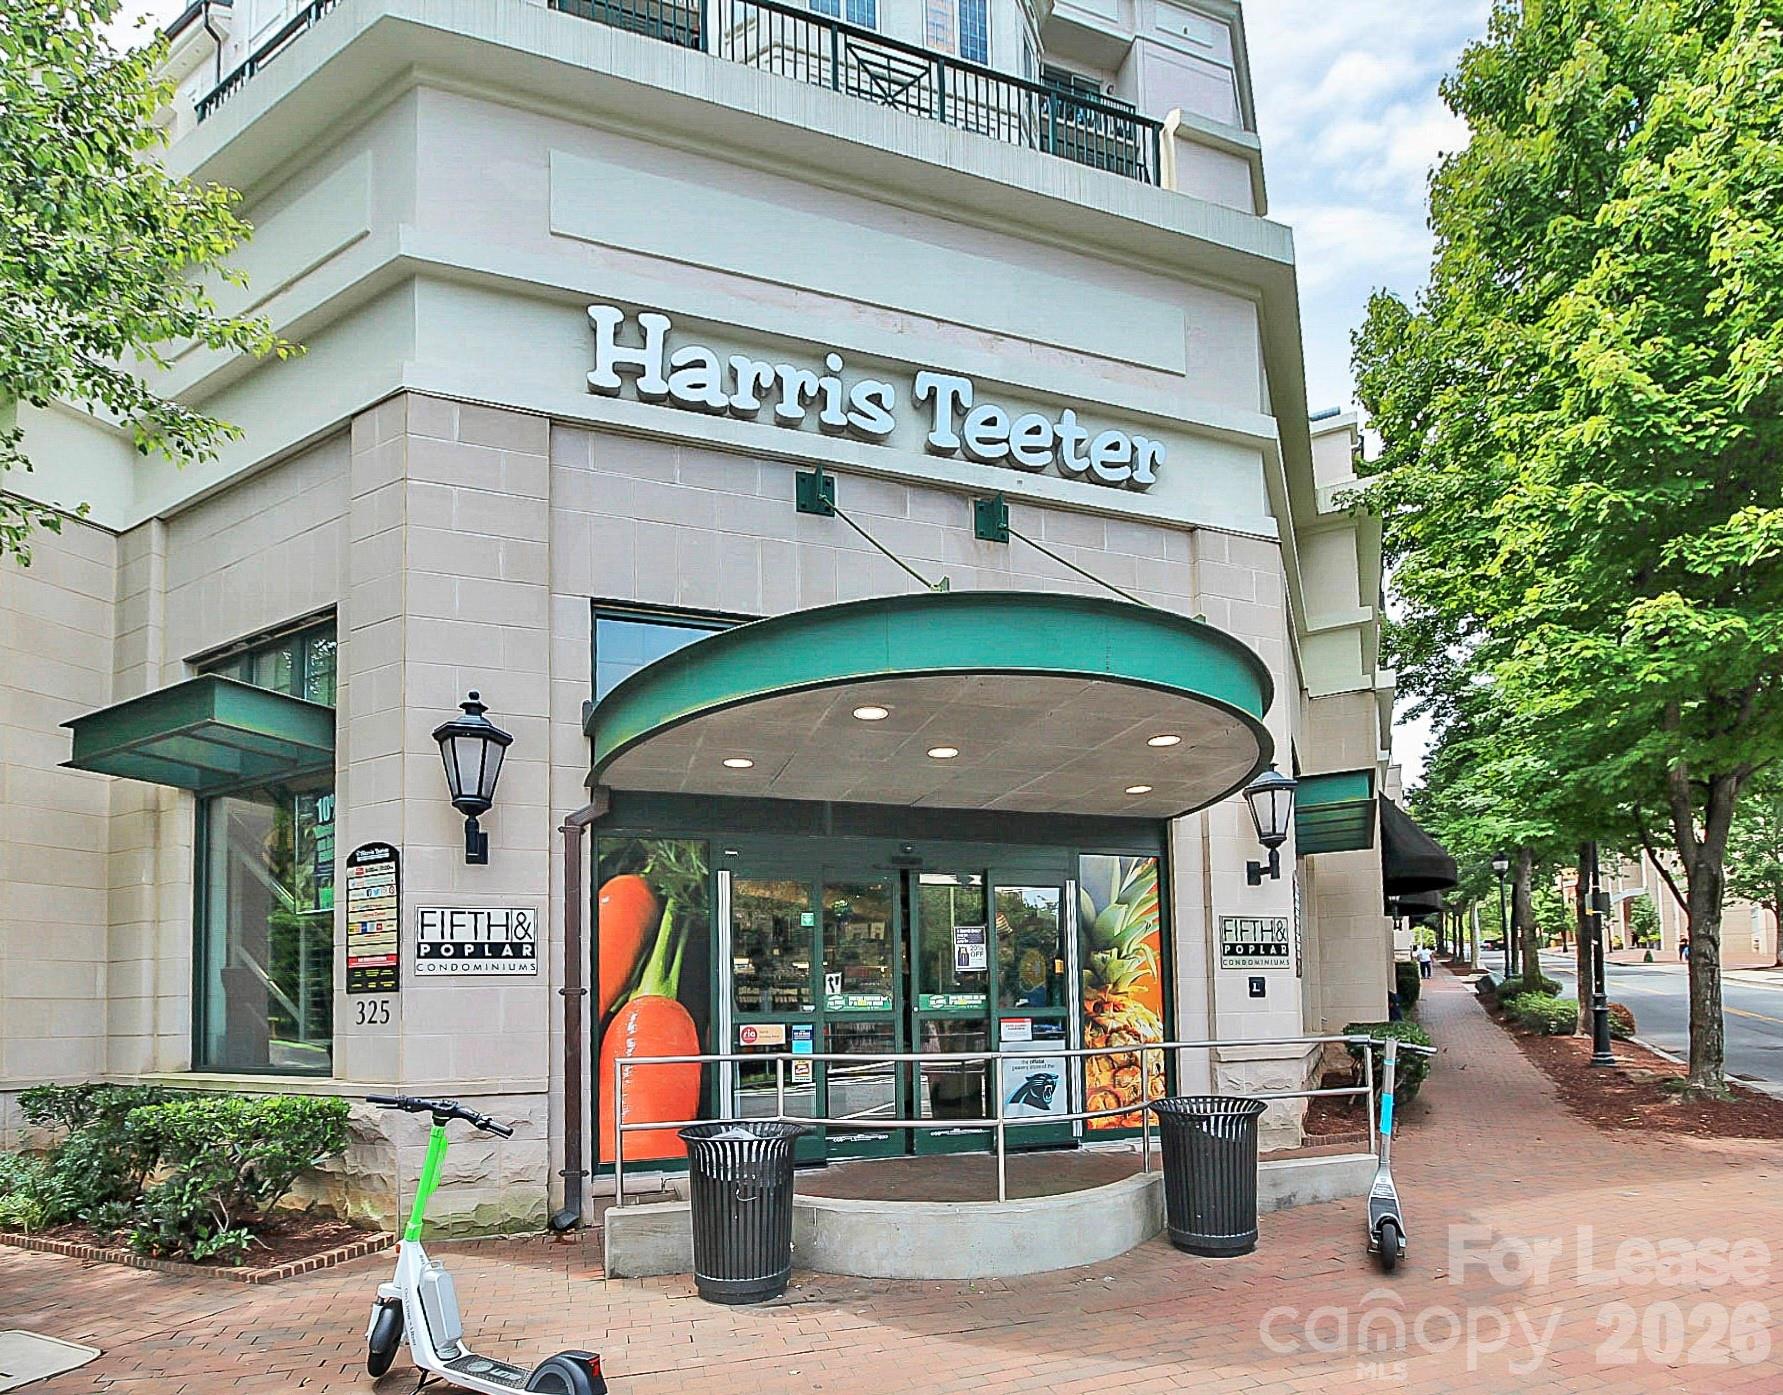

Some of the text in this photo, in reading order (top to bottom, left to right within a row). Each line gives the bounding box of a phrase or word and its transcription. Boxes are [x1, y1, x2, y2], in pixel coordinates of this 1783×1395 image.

[586, 304, 1166, 489] Harris Teeter
[420, 943, 533, 957] POPLAR
[1224, 944, 1287, 955] POPLAR
[416, 963, 536, 972] CONDOMINIUMS
[356, 1000, 390, 1025] 325
[743, 1029, 756, 1038] ria
